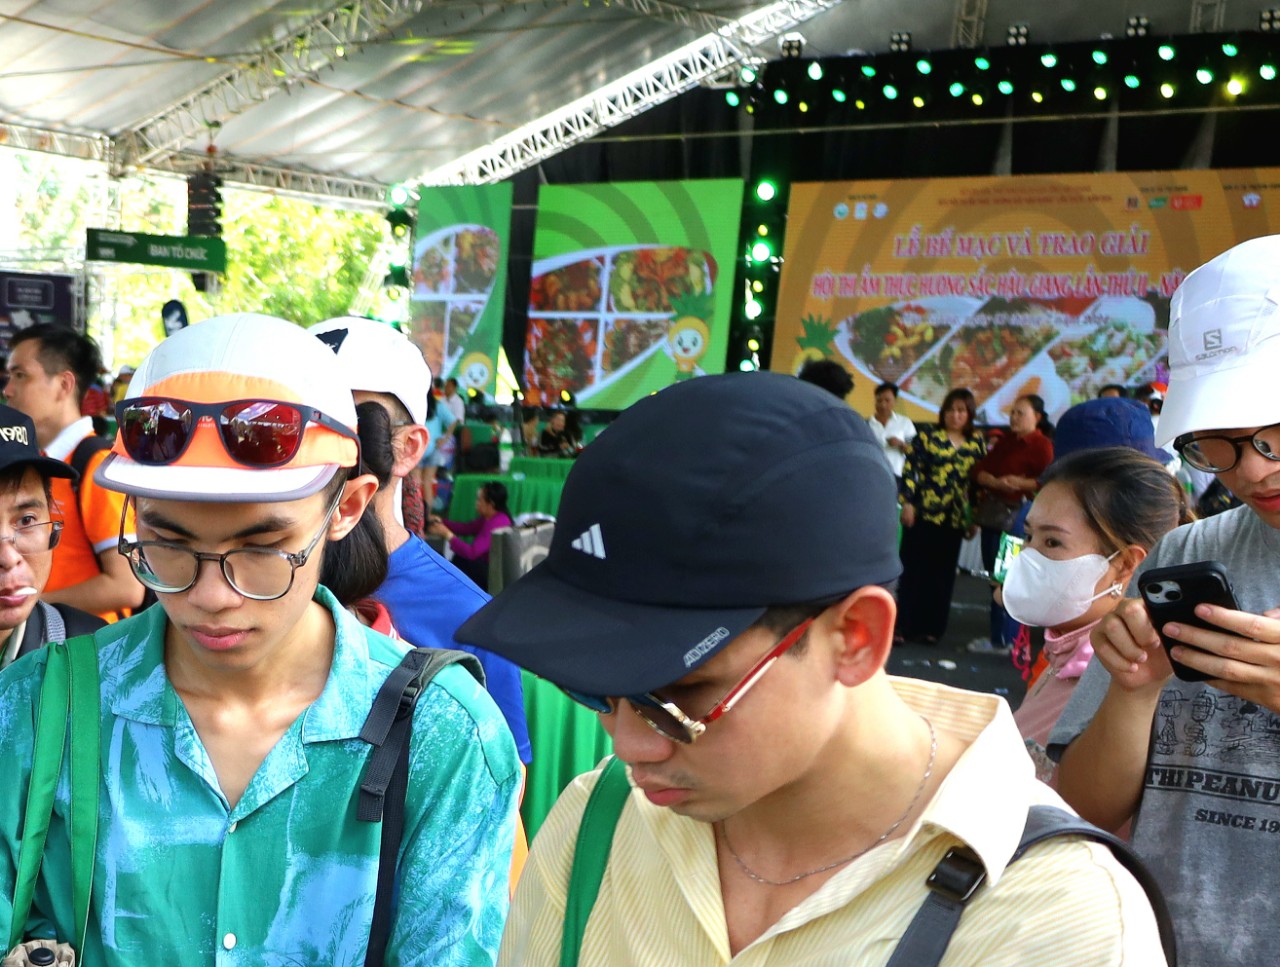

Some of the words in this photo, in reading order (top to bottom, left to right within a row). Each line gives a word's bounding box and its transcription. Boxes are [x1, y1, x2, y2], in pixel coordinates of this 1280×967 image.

[1039, 231, 1097, 256] TRAO
[683, 626, 730, 668] ADIZERO
[1194, 808, 1257, 830] SINCE
